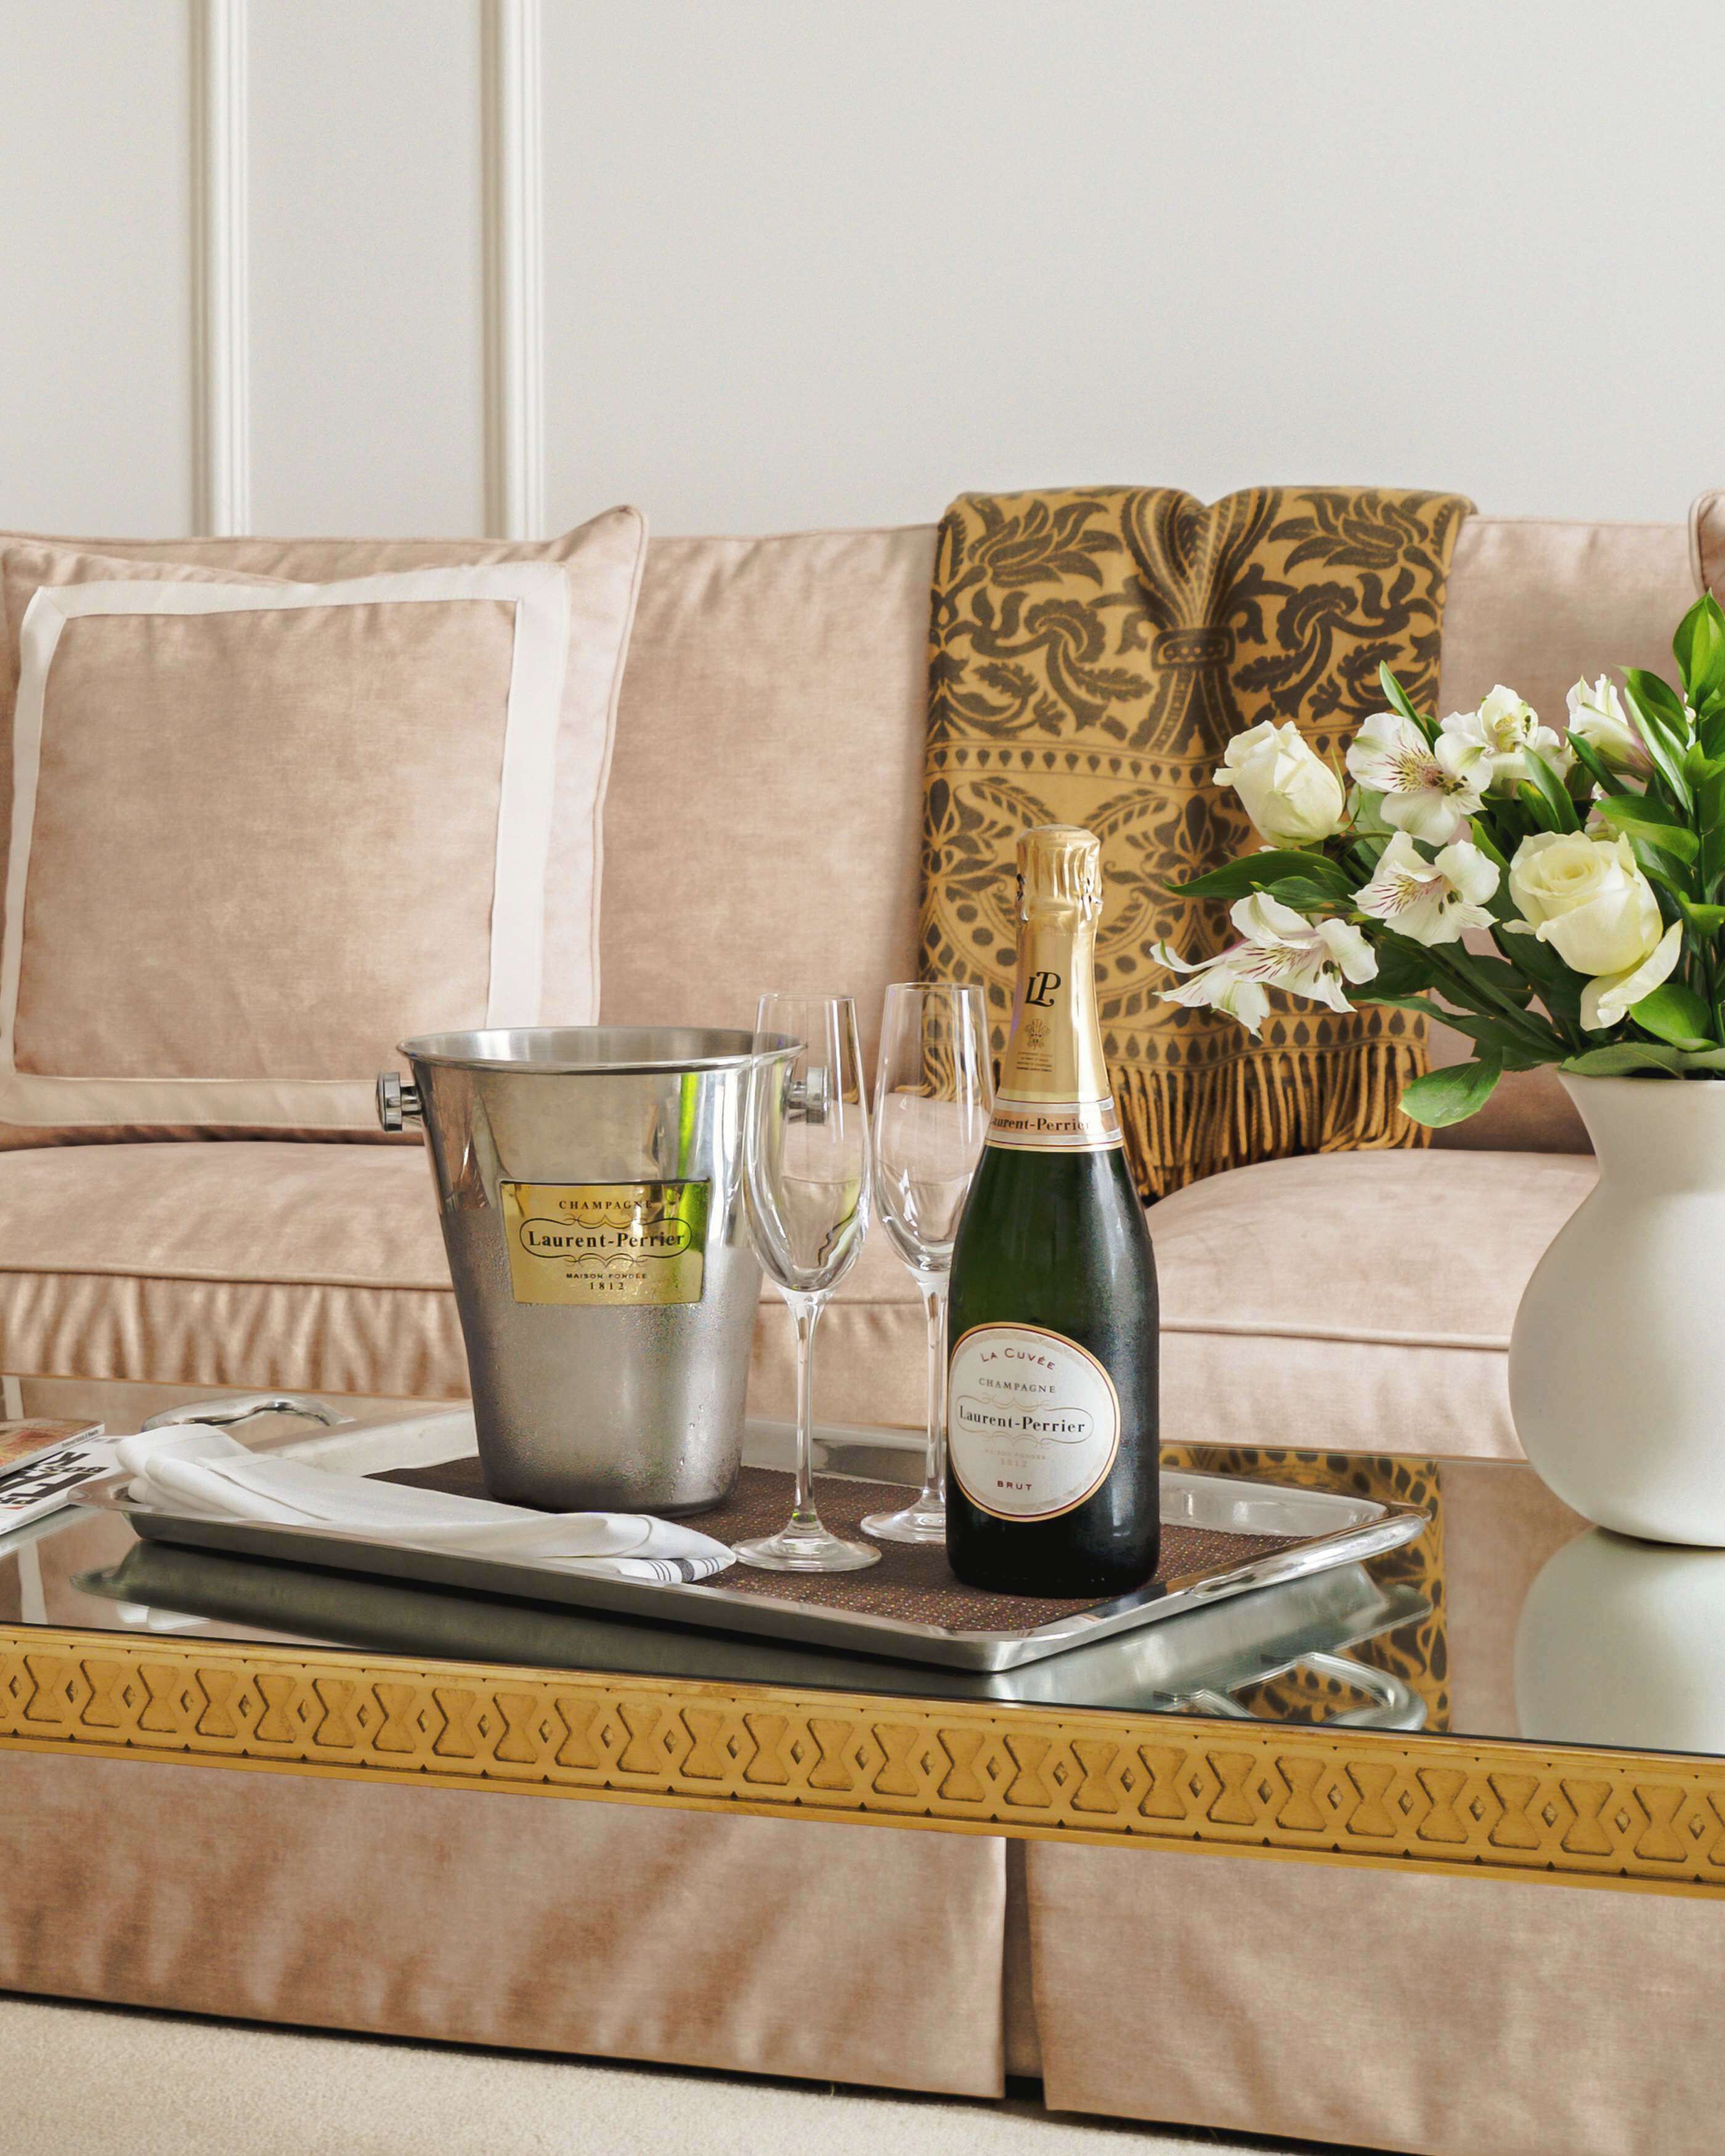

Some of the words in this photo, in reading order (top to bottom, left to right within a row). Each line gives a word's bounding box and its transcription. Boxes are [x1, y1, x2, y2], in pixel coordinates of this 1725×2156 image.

[559, 1201, 652, 1210] CHAMPAGNE
[527, 1231, 684, 1247] Laurent-Perrier
[590, 1282, 623, 1290] 1812
[980, 1352, 998, 1363] LA
[978, 1377, 1055, 1393] CHAMPAGNE
[959, 1405, 1086, 1433] Laurent-Perrier
[1000, 1458, 1027, 1468] 1812
[997, 1480, 1033, 1491] BRUT
